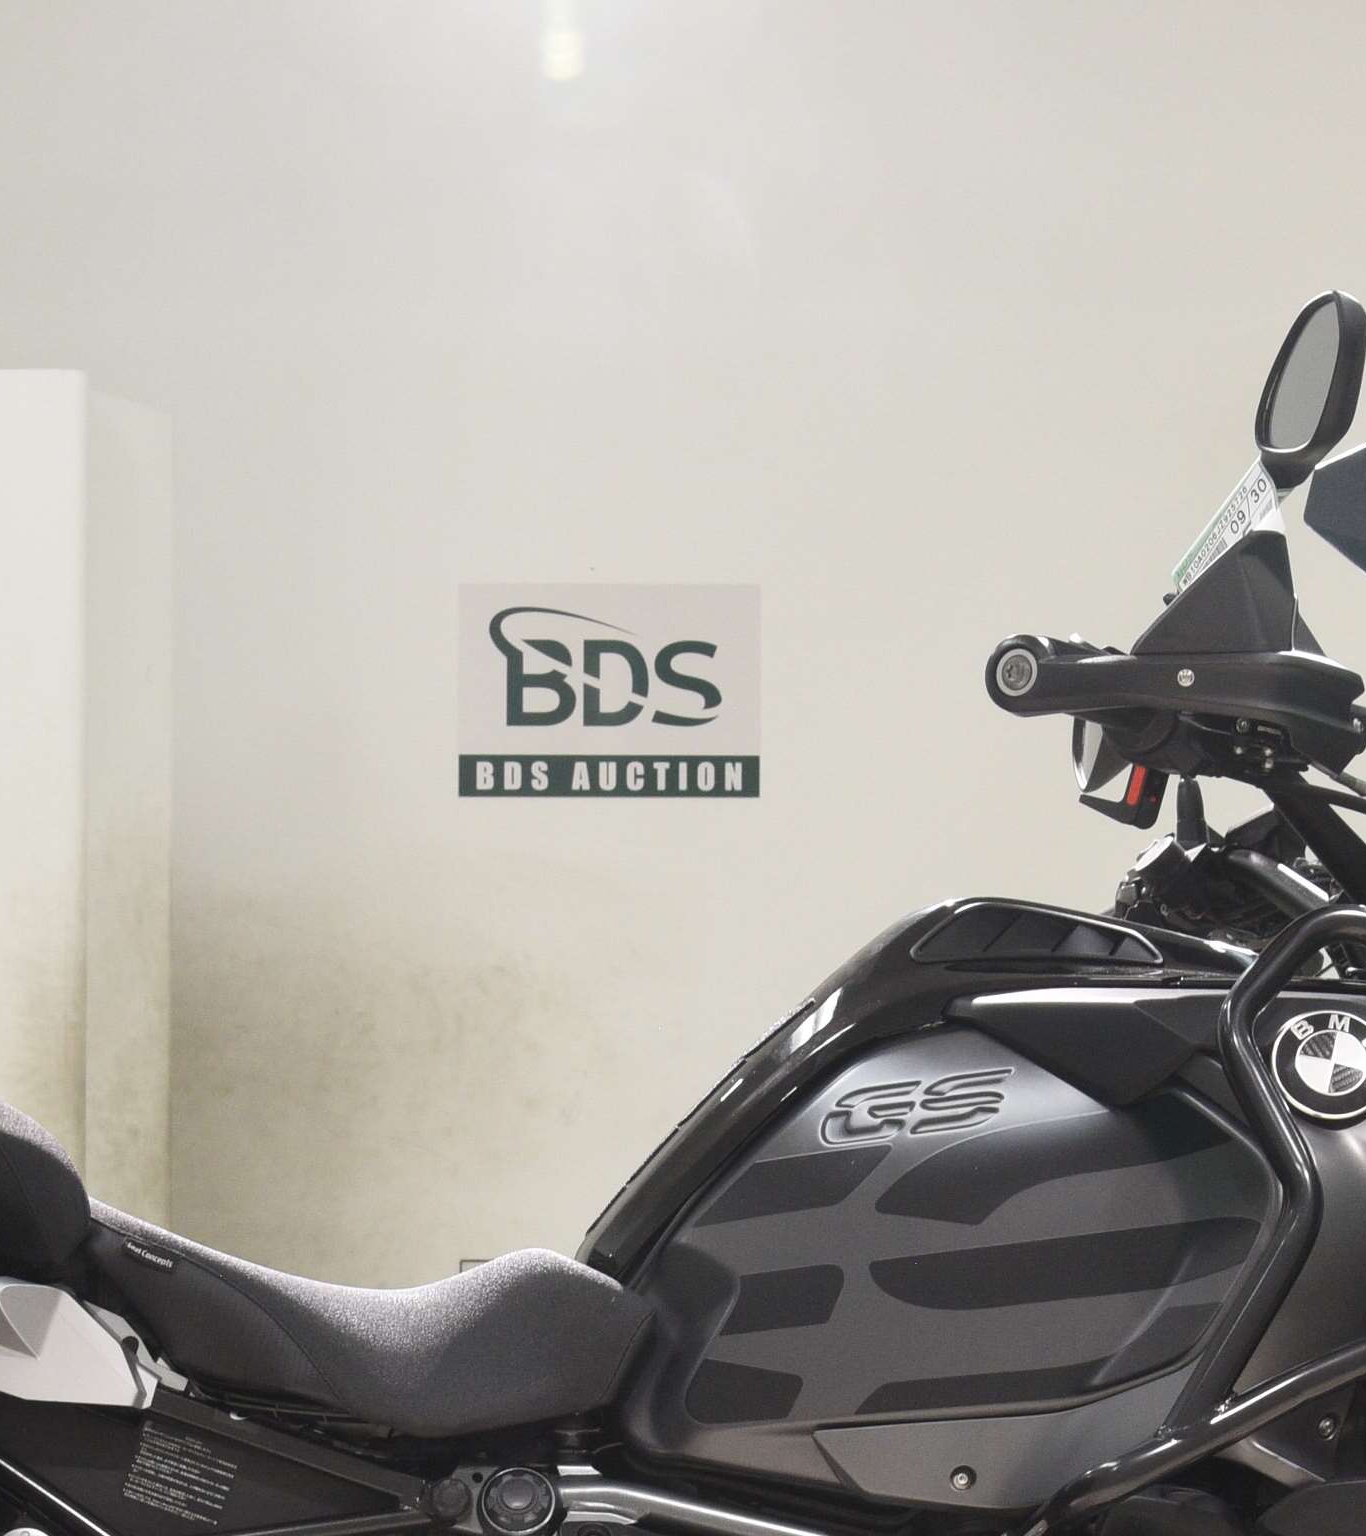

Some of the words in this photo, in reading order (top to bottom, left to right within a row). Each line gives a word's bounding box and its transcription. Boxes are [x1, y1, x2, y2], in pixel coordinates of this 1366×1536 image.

[489, 606, 722, 726] BDS
[476, 761, 549, 791] BDS
[571, 761, 743, 792] AUCTION
[820, 1067, 1015, 1148] GS
